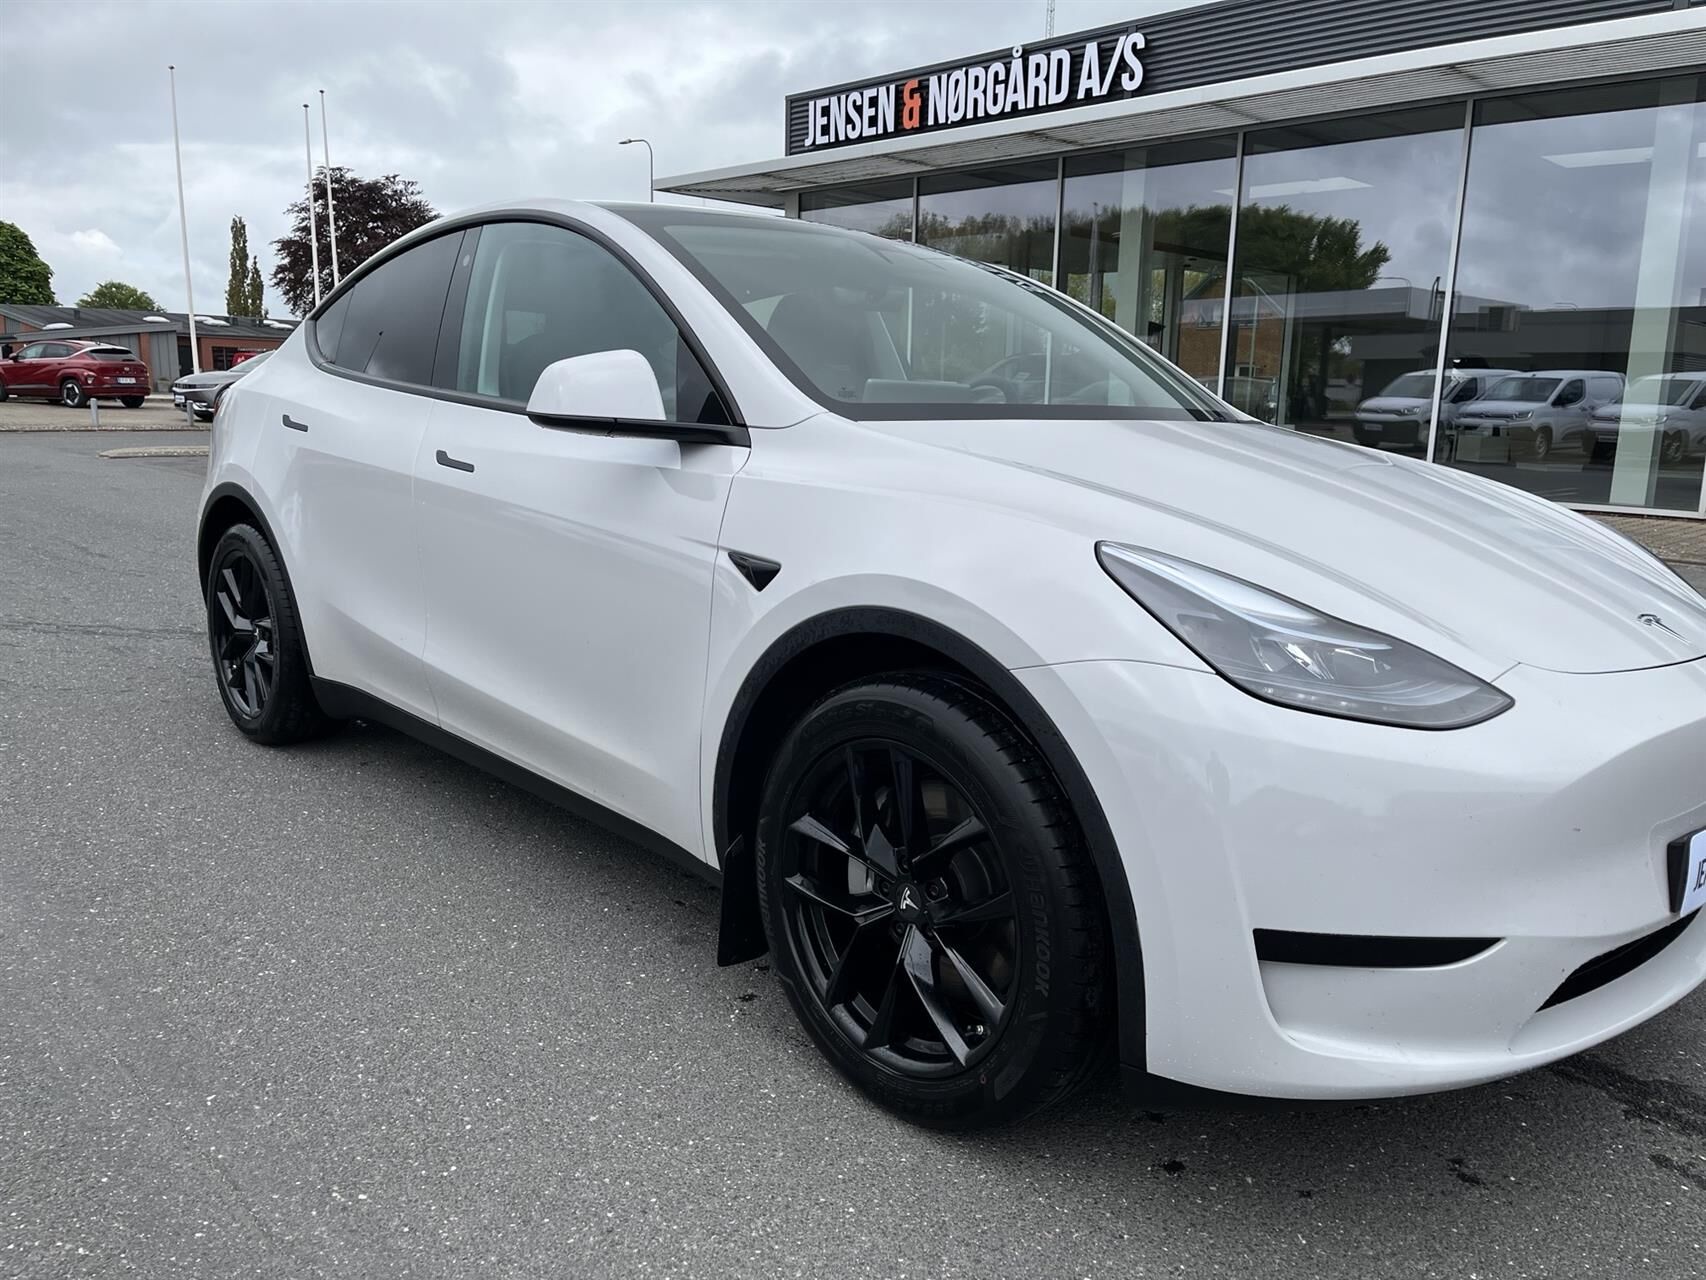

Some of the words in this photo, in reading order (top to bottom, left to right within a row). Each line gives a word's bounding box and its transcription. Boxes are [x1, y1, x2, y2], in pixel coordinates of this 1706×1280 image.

[804, 84, 896, 147] JENSEN
[902, 79, 921, 130] &
[927, 44, 1071, 126] NØRGÅRD
[1076, 32, 1146, 100] A/S
